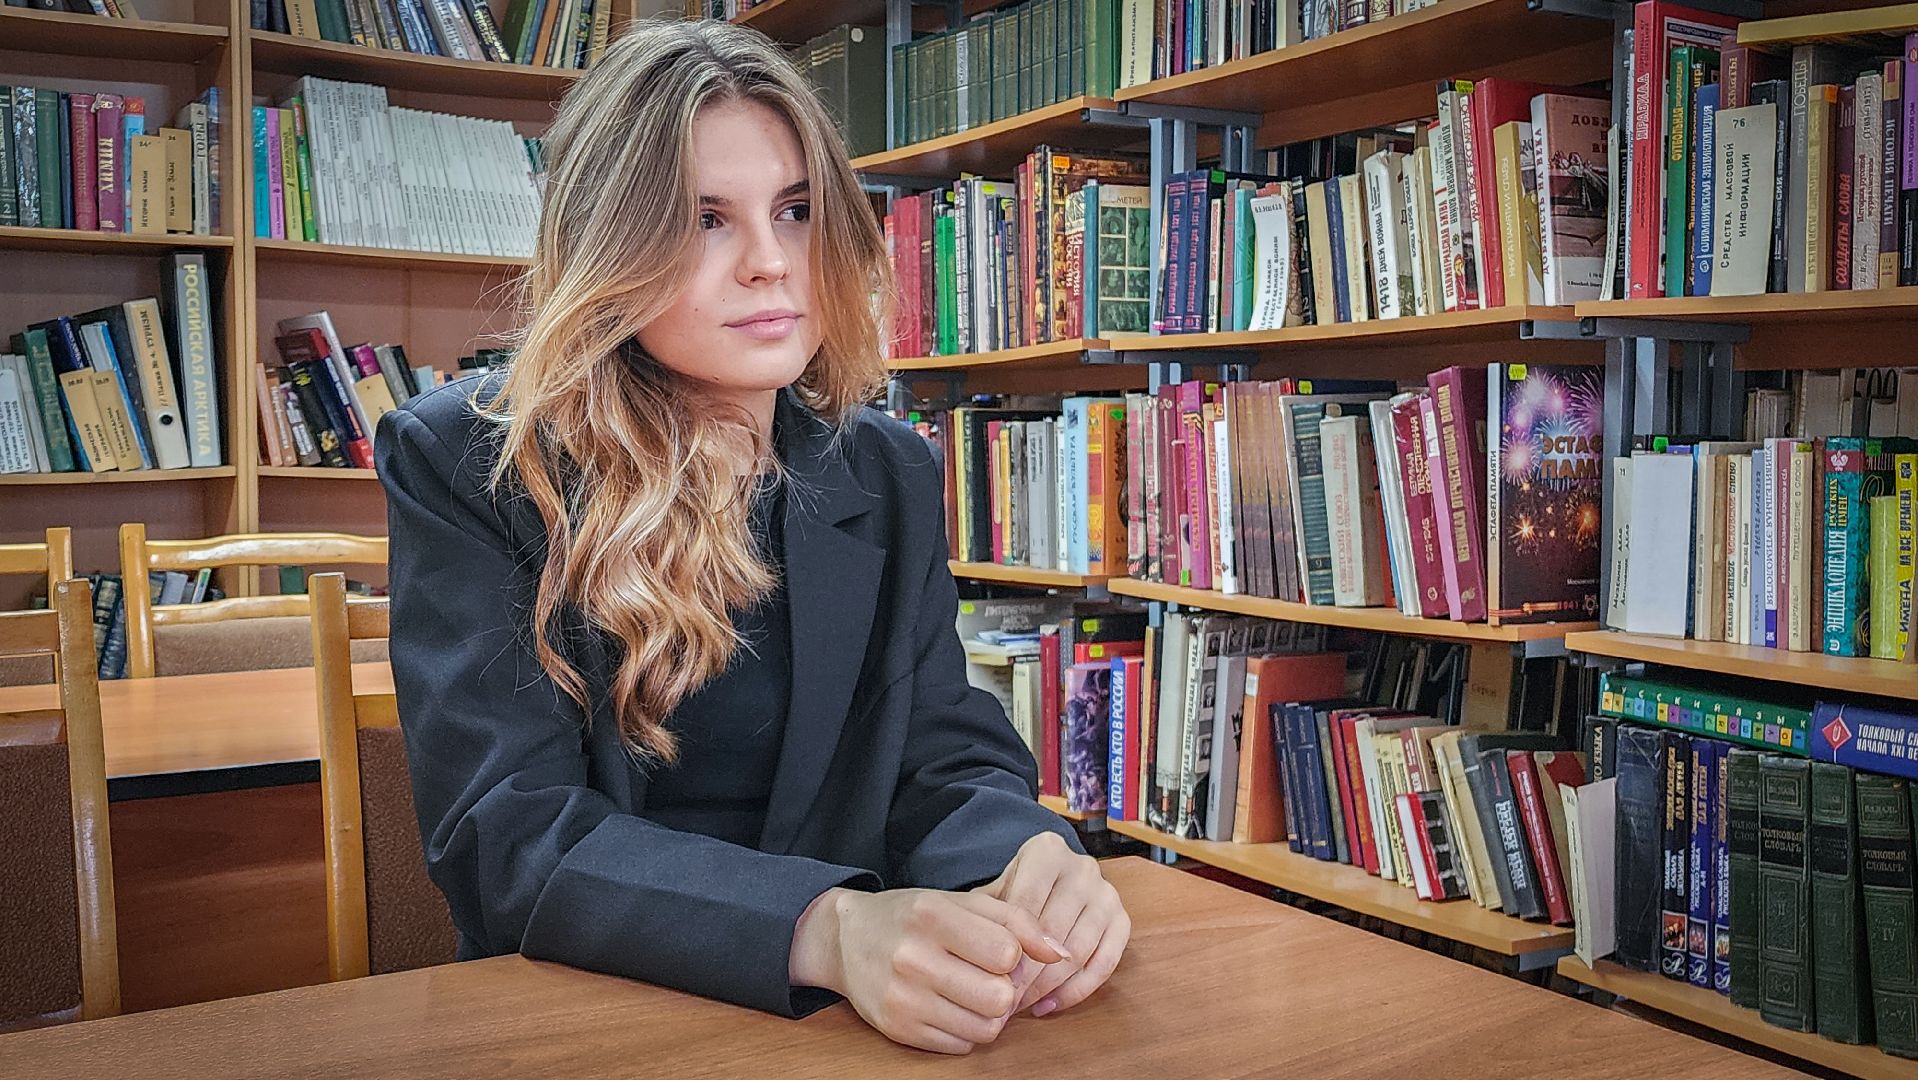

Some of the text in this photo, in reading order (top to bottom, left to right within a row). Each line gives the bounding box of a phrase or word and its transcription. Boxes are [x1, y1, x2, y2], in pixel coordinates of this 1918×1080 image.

[1635, 72, 1650, 141] ПРАВИЛА
[1793, 59, 1807, 117] ПОБЕДЫ
[1670, 107, 1684, 161] ФУТБОЛЬНАЯ
[1732, 118, 1746, 129] 76
[98, 137, 114, 194] ХИМИЯ
[1442, 124, 1459, 224] ВТОРАЯ МИРОВАЯ ВОЙНА
[1502, 157, 1512, 191] СЛАВЫ
[1699, 105, 1713, 252] ОЛИМПИЙСКАЯ ЭНЦИКЛОПЕДИЯ
[1776, 176, 1784, 200] СМИ
[1883, 119, 1895, 226] ИСТОРИЯ ПЕЧАТИ
[1534, 128, 1550, 275] ДОБЛЕСТЬ НА ВЕКА
[1720, 142, 1734, 268] СРЕДСТВА МАССОВОЙ
[1739, 153, 1751, 237] ИНФОРМАЦИИ
[1857, 187, 1866, 223] История
[1375, 212, 1385, 245] ВОЙНЫ
[1438, 201, 1454, 298] СТАЛИНГРАДСКАЯ БИТВА
[1505, 202, 1515, 249] ПАМЯТИ
[1835, 172, 1851, 284] СОЛДАТЫ СЛОВА
[1377, 247, 1387, 273] ДНЕЙ
[1508, 251, 1516, 278] КНИГА
[1379, 277, 1390, 314] 1418
[140, 310, 154, 348] ТУРИЗМ
[183, 264, 213, 456] РОССИЙСКАЯ АРКТИКА
[1437, 384, 1453, 423] ВОЙНА
[1410, 416, 1425, 494] ОТЕЧЕСТВЕННАЯ
[1442, 424, 1465, 509] ОТЕЧЕСТВЕННАЯ
[1729, 462, 1737, 494] СЛОВО
[1070, 494, 1078, 544] РУССКАЯ
[1764, 445, 1774, 606] УДИВИТЕЛЬНАЯ ЭТИМОЛОГИЯ
[1792, 501, 1800, 561] ПУТЕШЕСТВИЕ
[1838, 496, 1848, 527] ИМЕН
[1826, 478, 1847, 633] ЭНЦИКЛОПЕДИЯ РУССКИХ
[1899, 489, 1912, 633] ИМЕНА НА ВСЕ ВРЕМЕНА
[1111, 671, 1123, 809] КТО ЕСТЬ КТО В РОССИИ
[1736, 707, 1807, 728] ЯЗЫК
[1858, 724, 1905, 742] ТОЛКОВЫЙ
[1594, 726, 1602, 764] ЯЗЫКА
[1856, 739, 1887, 755] НАЧАЛА
[1890, 744, 1905, 757] XXI
[1762, 829, 1803, 841] ТОЛКОВЫЙ
[1764, 840, 1802, 853] СЛОВАРЬ
[1862, 849, 1907, 861] ТОЛКОВЫЙ
[1866, 861, 1905, 872] СЛОВАРЬ
